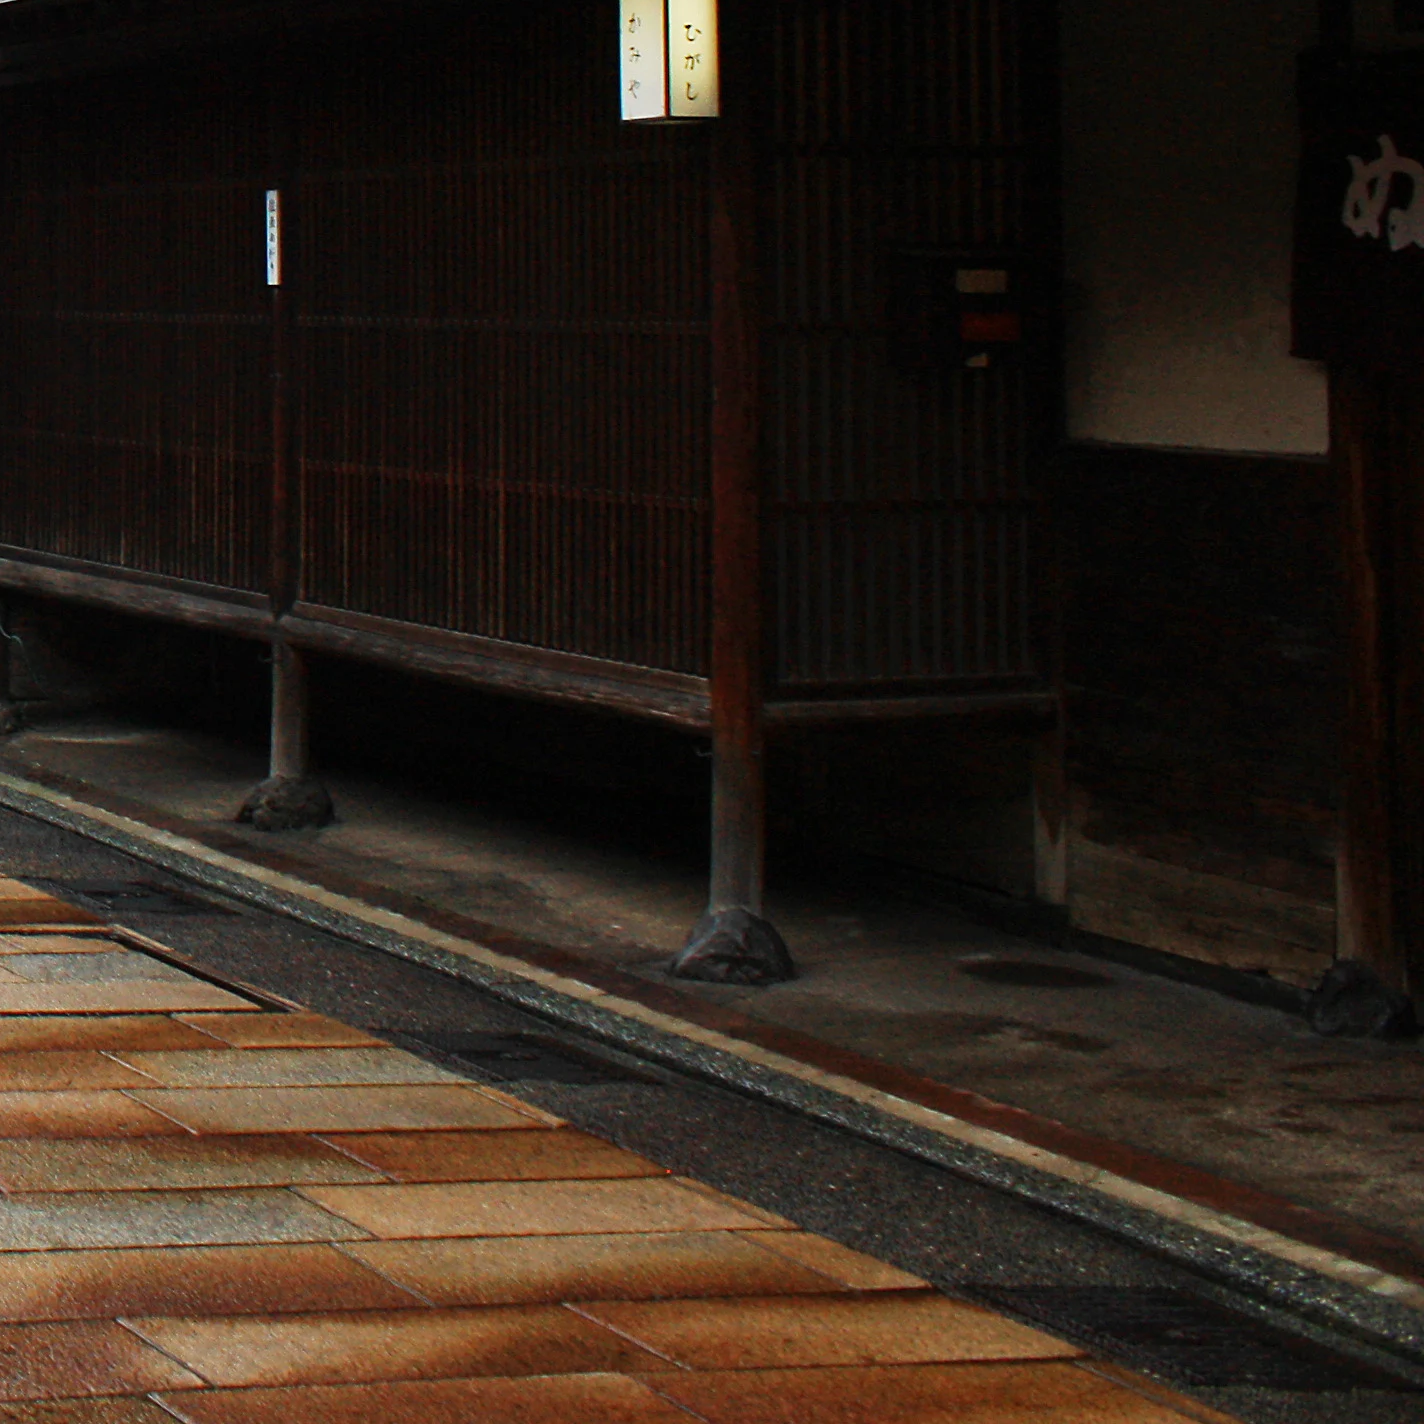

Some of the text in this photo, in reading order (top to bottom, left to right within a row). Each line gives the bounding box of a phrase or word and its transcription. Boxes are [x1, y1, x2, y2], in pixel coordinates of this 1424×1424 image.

[628, 13, 641, 99] かみや
[684, 23, 702, 100] ひがし
